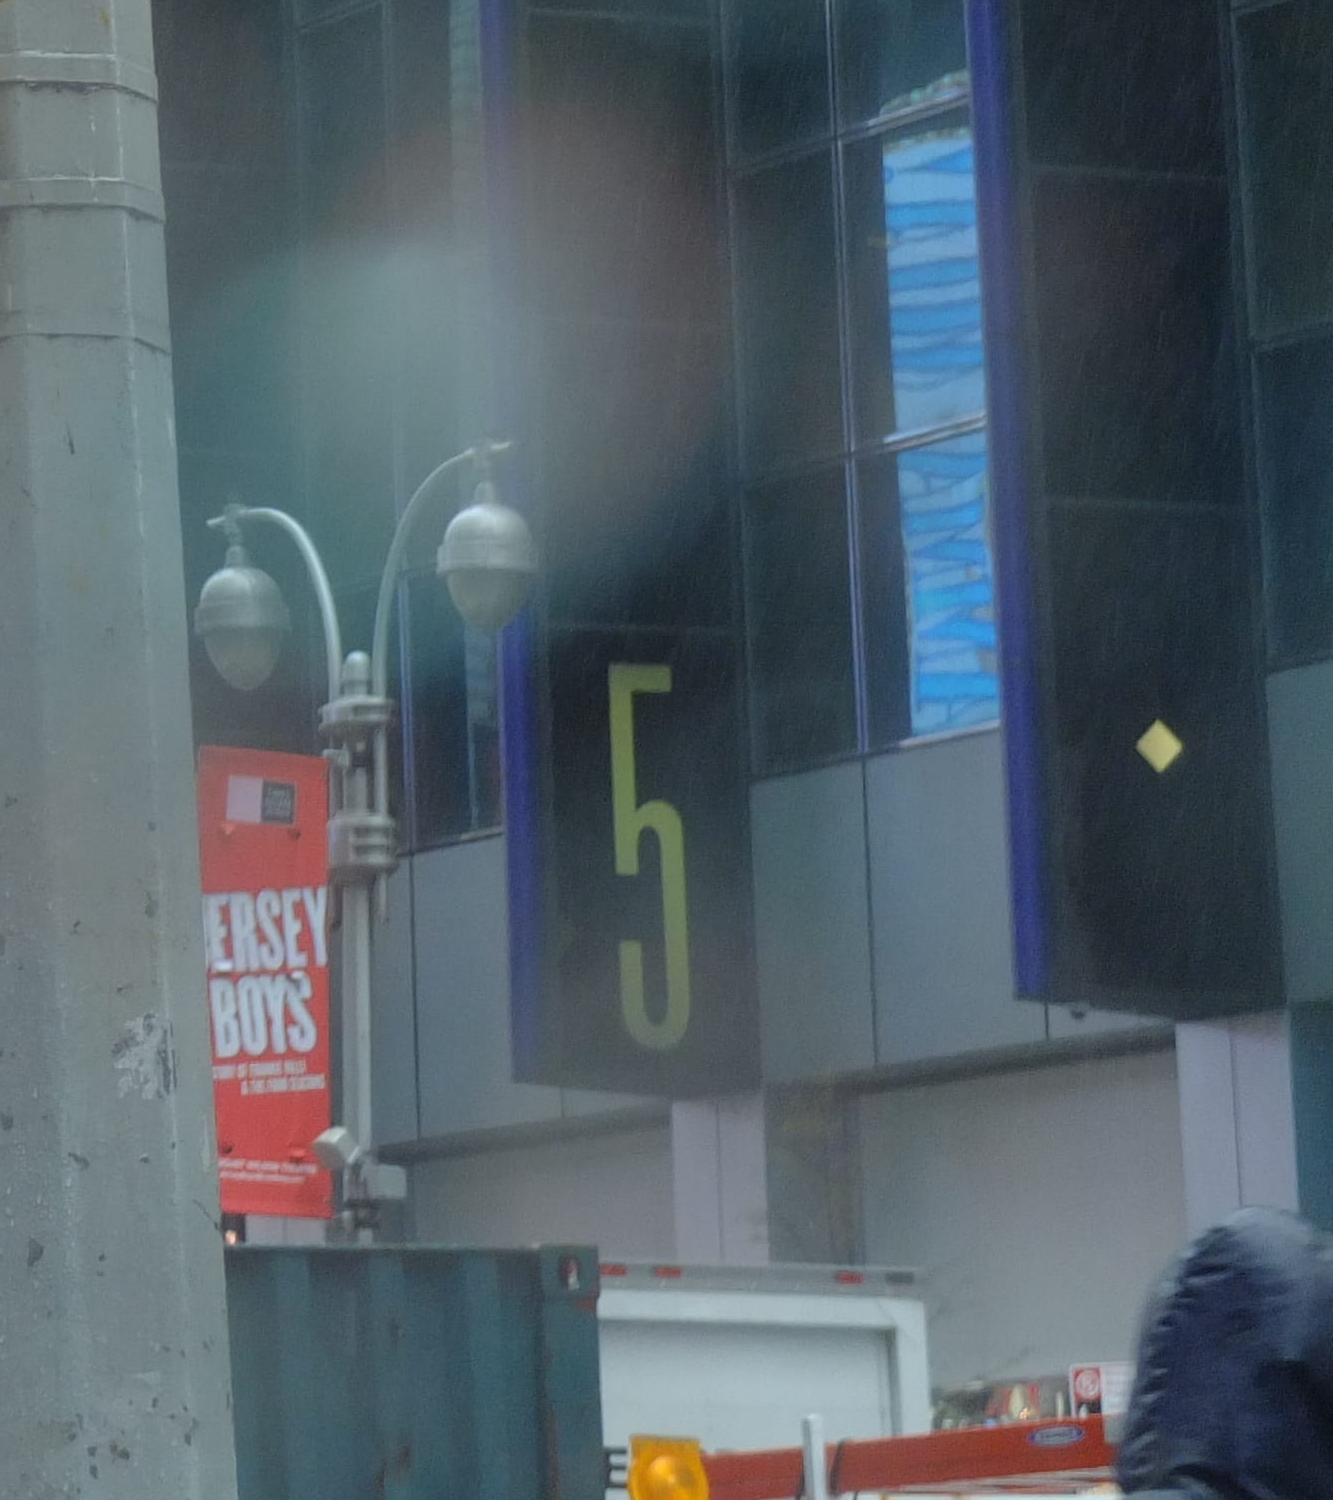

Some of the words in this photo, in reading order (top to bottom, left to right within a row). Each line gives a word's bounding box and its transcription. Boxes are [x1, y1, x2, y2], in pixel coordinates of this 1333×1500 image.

[607, 664, 691, 1051] 5
[202, 885, 328, 973] ERSEY
[209, 970, 317, 1059] BOYS
